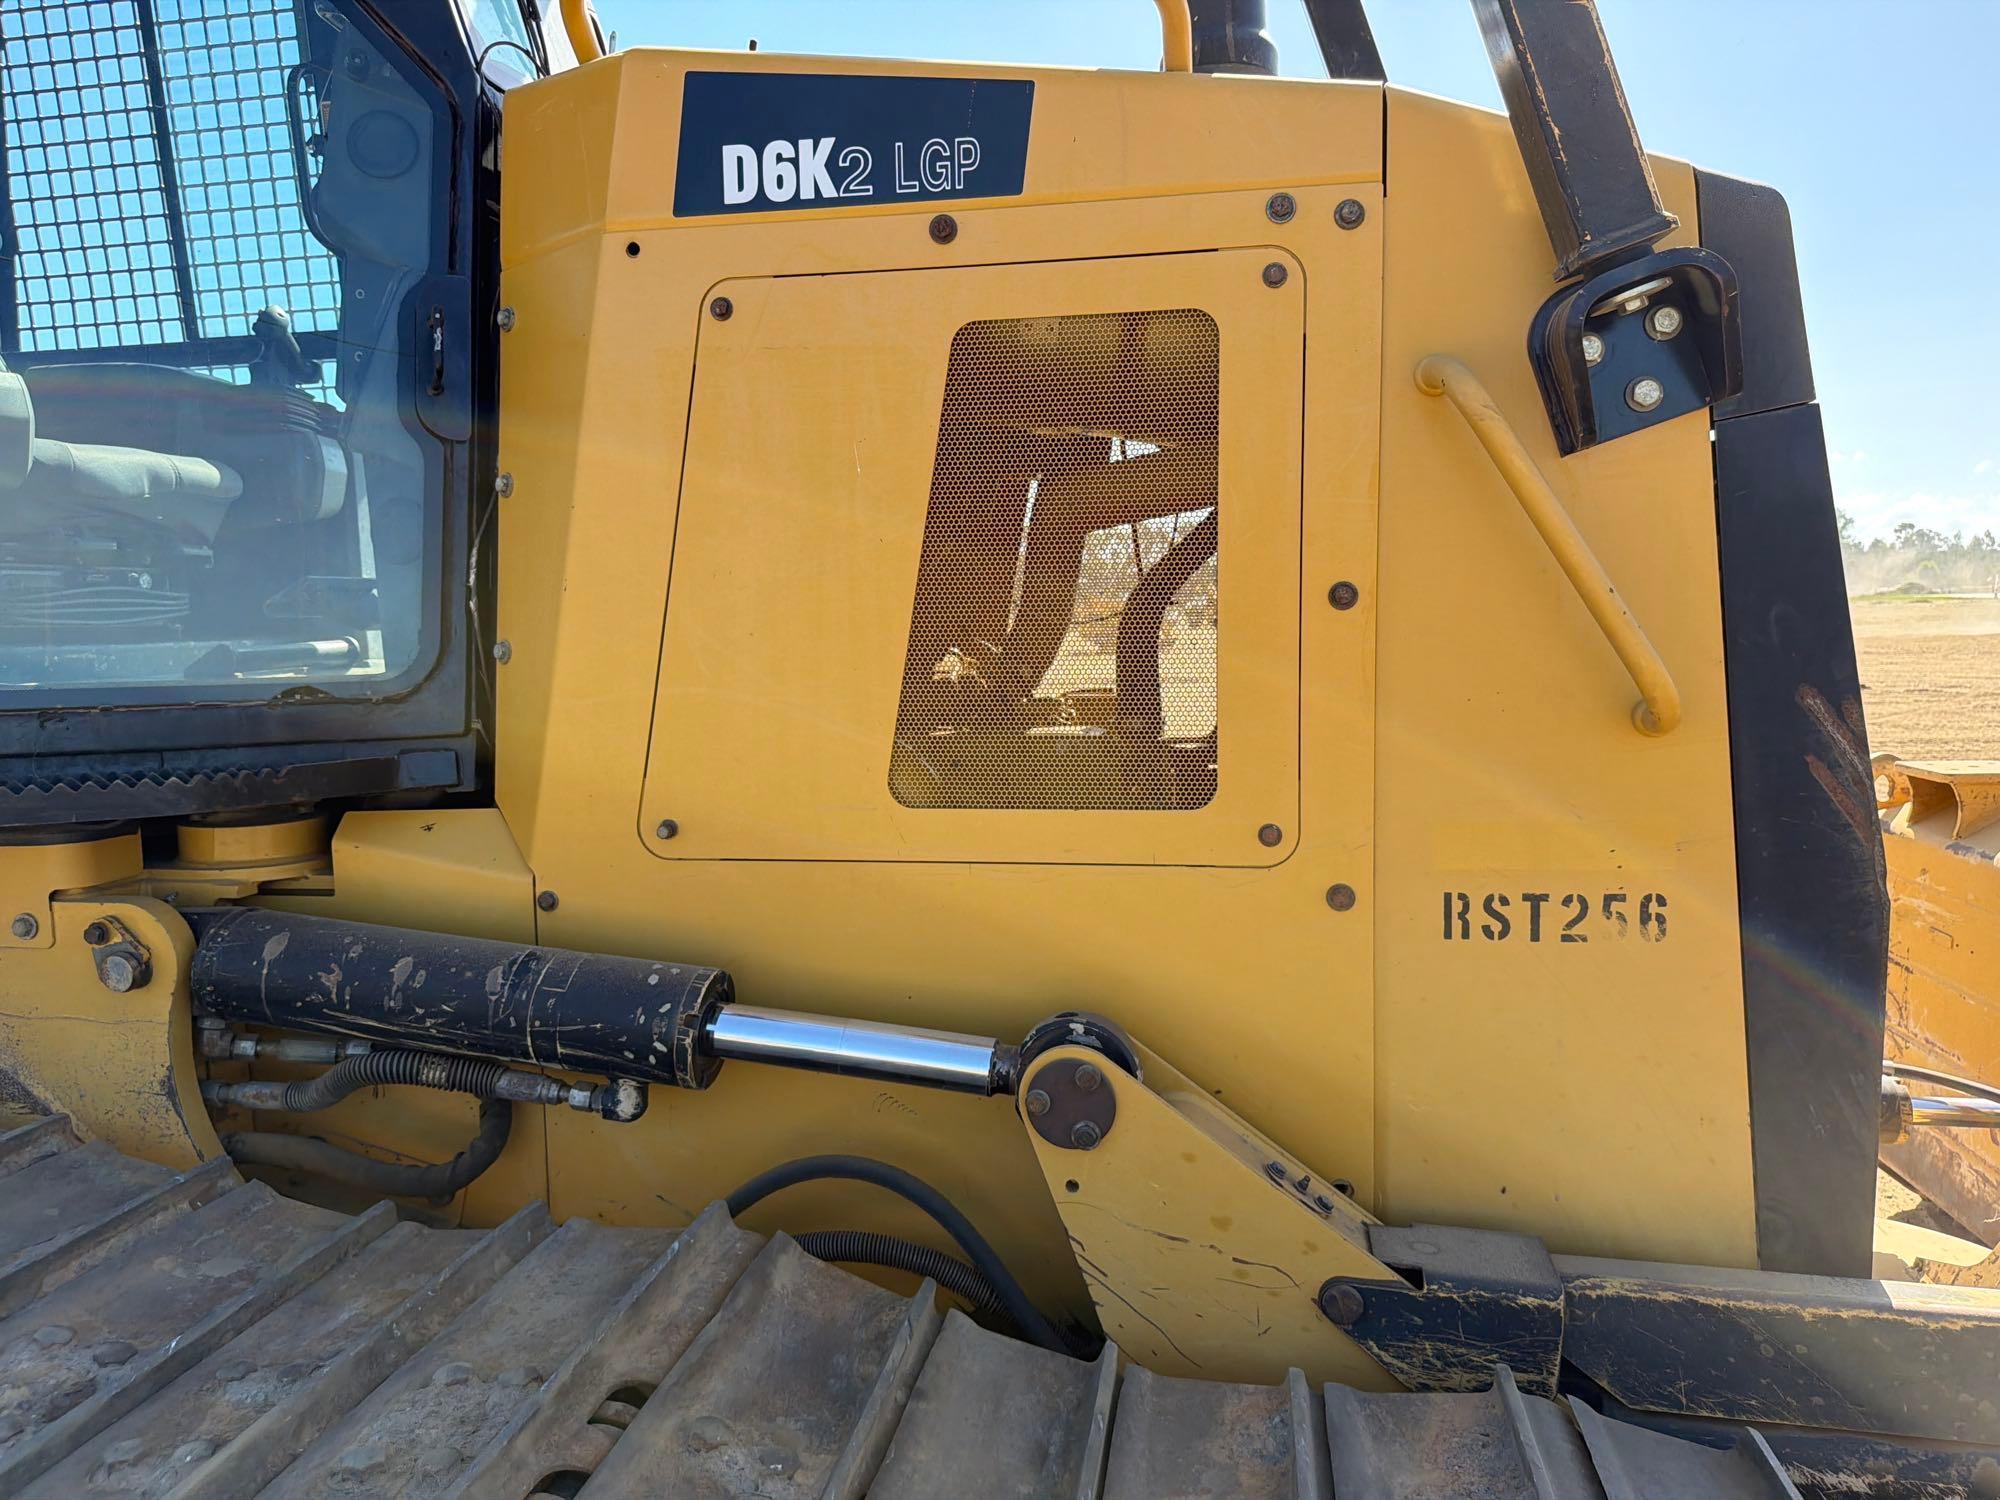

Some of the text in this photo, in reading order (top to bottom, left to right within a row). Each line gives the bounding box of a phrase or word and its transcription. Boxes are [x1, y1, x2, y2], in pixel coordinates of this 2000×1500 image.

[722, 137, 980, 204] D6K2 LGP
[1443, 892, 1668, 942] RST256
